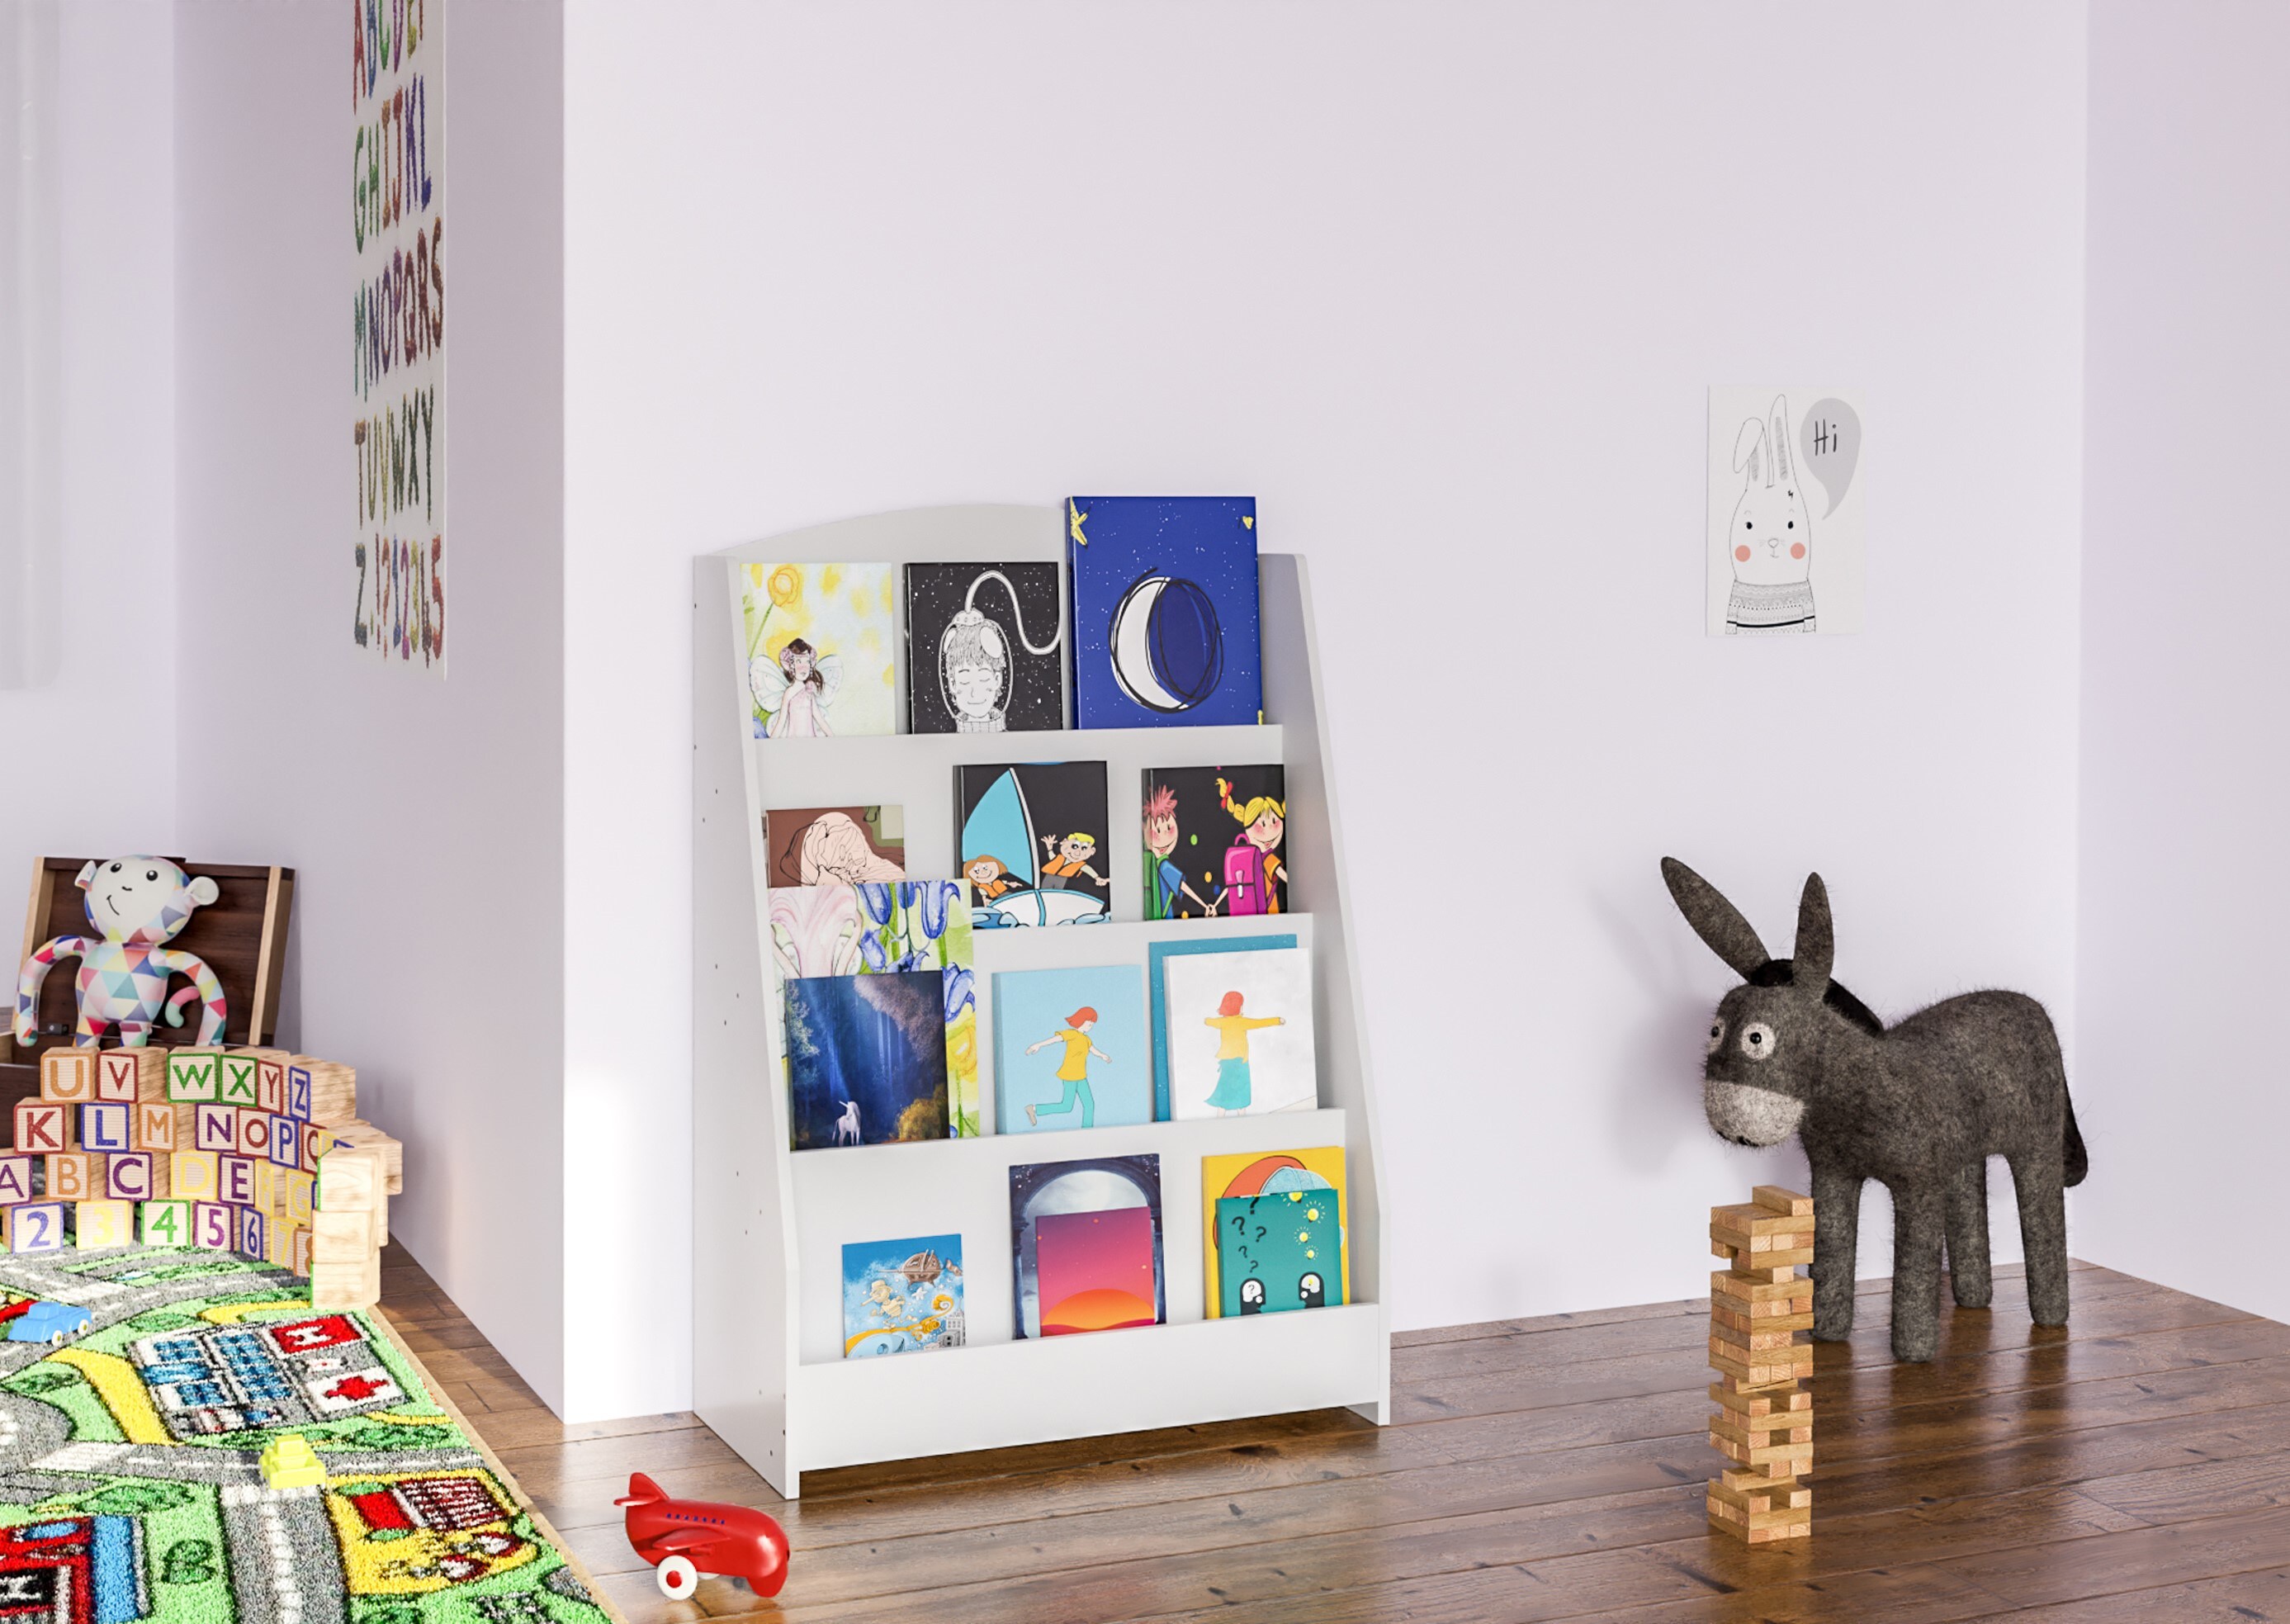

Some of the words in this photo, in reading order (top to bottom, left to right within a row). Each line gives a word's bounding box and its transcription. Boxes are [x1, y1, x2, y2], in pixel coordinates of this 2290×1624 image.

[1813, 418, 1838, 457] Hi
[50, 1059, 83, 1097] U
[107, 1061, 130, 1091] V
[173, 1063, 213, 1090] W
[228, 1063, 253, 1098] X
[265, 1069, 279, 1104] Y
[295, 1077, 306, 1112] Z
[26, 1111, 59, 1148] K
[95, 1109, 118, 1146] L
[147, 1109, 169, 1143] M
[207, 1113, 231, 1143] N
[245, 1118, 269, 1148] O
[279, 1121, 292, 1160] P
[0, 1163, 25, 1198] A
[58, 1158, 81, 1196] B
[113, 1158, 144, 1195] C
[180, 1157, 211, 1193] D
[231, 1161, 248, 1200] E
[292, 1178, 308, 1219] G
[27, 1210, 50, 1248] 2
[92, 1206, 115, 1244] 3
[151, 1205, 178, 1243] 4
[206, 1208, 225, 1247] 5
[248, 1215, 258, 1254] 6
[278, 1224, 294, 1262] 7
